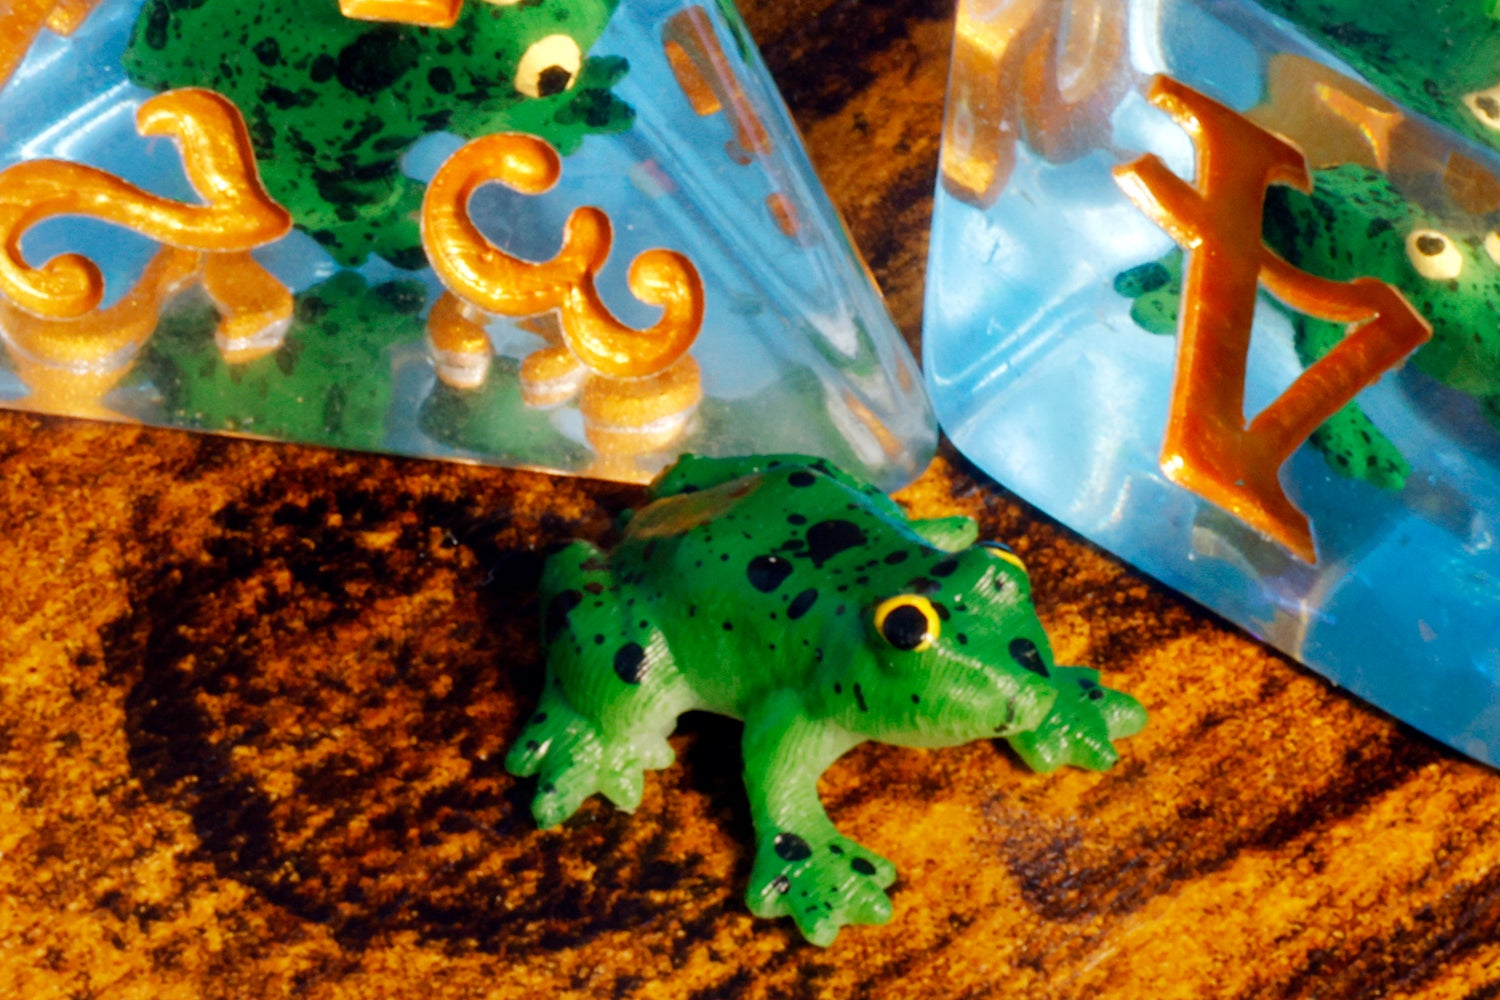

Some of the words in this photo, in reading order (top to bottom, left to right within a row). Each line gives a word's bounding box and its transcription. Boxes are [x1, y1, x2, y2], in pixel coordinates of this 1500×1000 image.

[0, 86, 293, 321] 2
[420, 131, 706, 380] 3
[1112, 74, 1434, 565] 4
